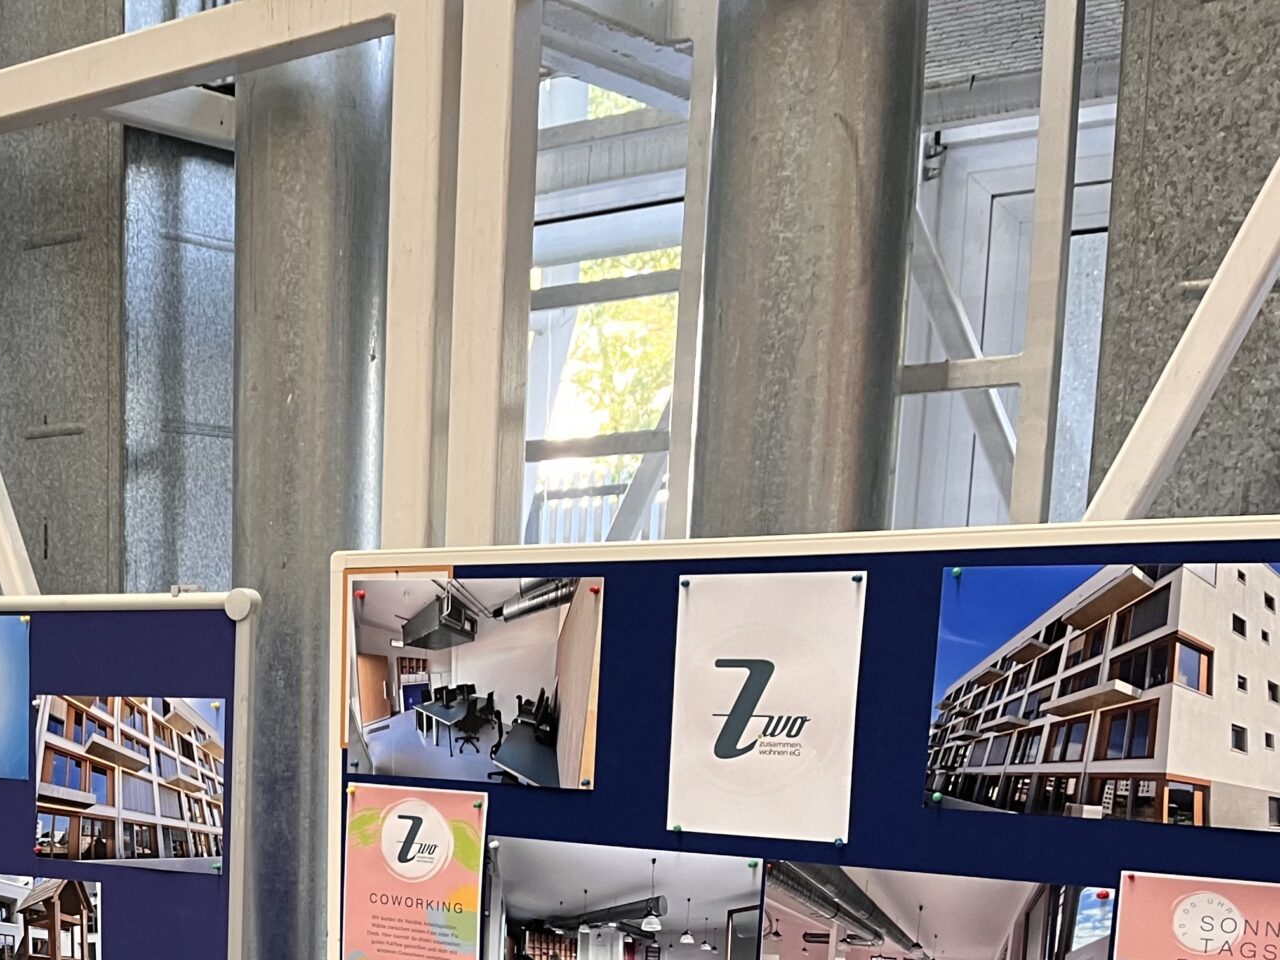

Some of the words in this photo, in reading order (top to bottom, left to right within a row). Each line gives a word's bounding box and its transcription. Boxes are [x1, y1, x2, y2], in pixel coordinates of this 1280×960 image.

[369, 892, 463, 914] COWORKING
[1207, 898, 1234, 914] UHR
[1200, 938, 1278, 960] TAGS
